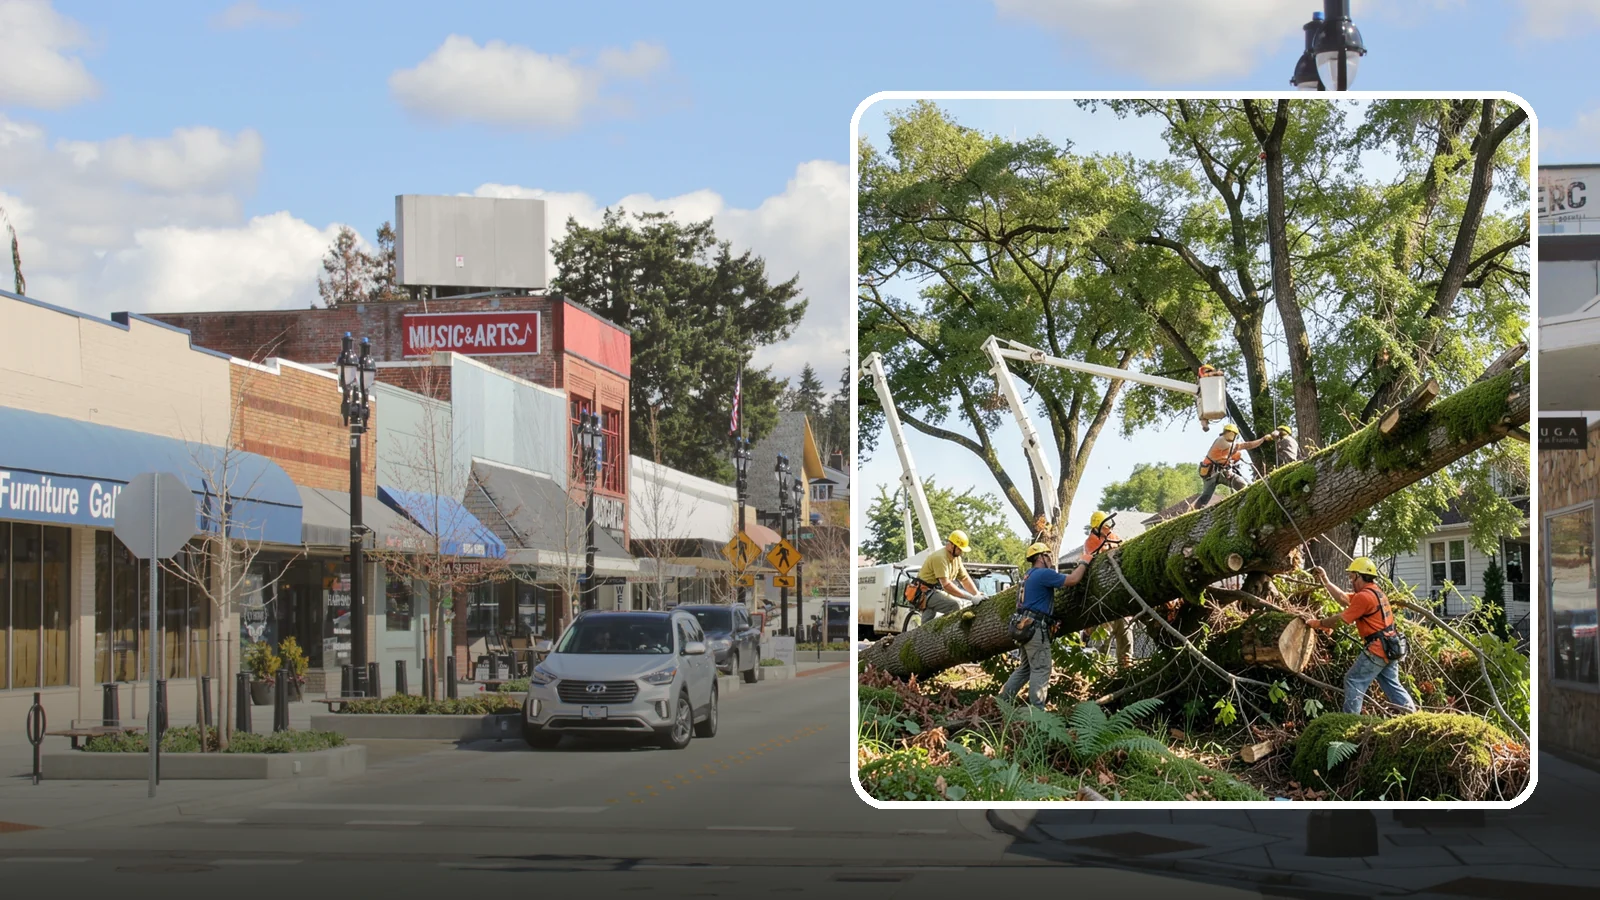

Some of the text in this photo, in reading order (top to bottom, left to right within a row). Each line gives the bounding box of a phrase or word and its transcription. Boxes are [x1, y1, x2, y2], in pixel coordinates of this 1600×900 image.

[408, 322, 520, 349] MUSIC&ARTS
[1540, 427, 1577, 436] UGA
[0, 471, 79, 515] Furniture
[89, 482, 122, 519] Gal
